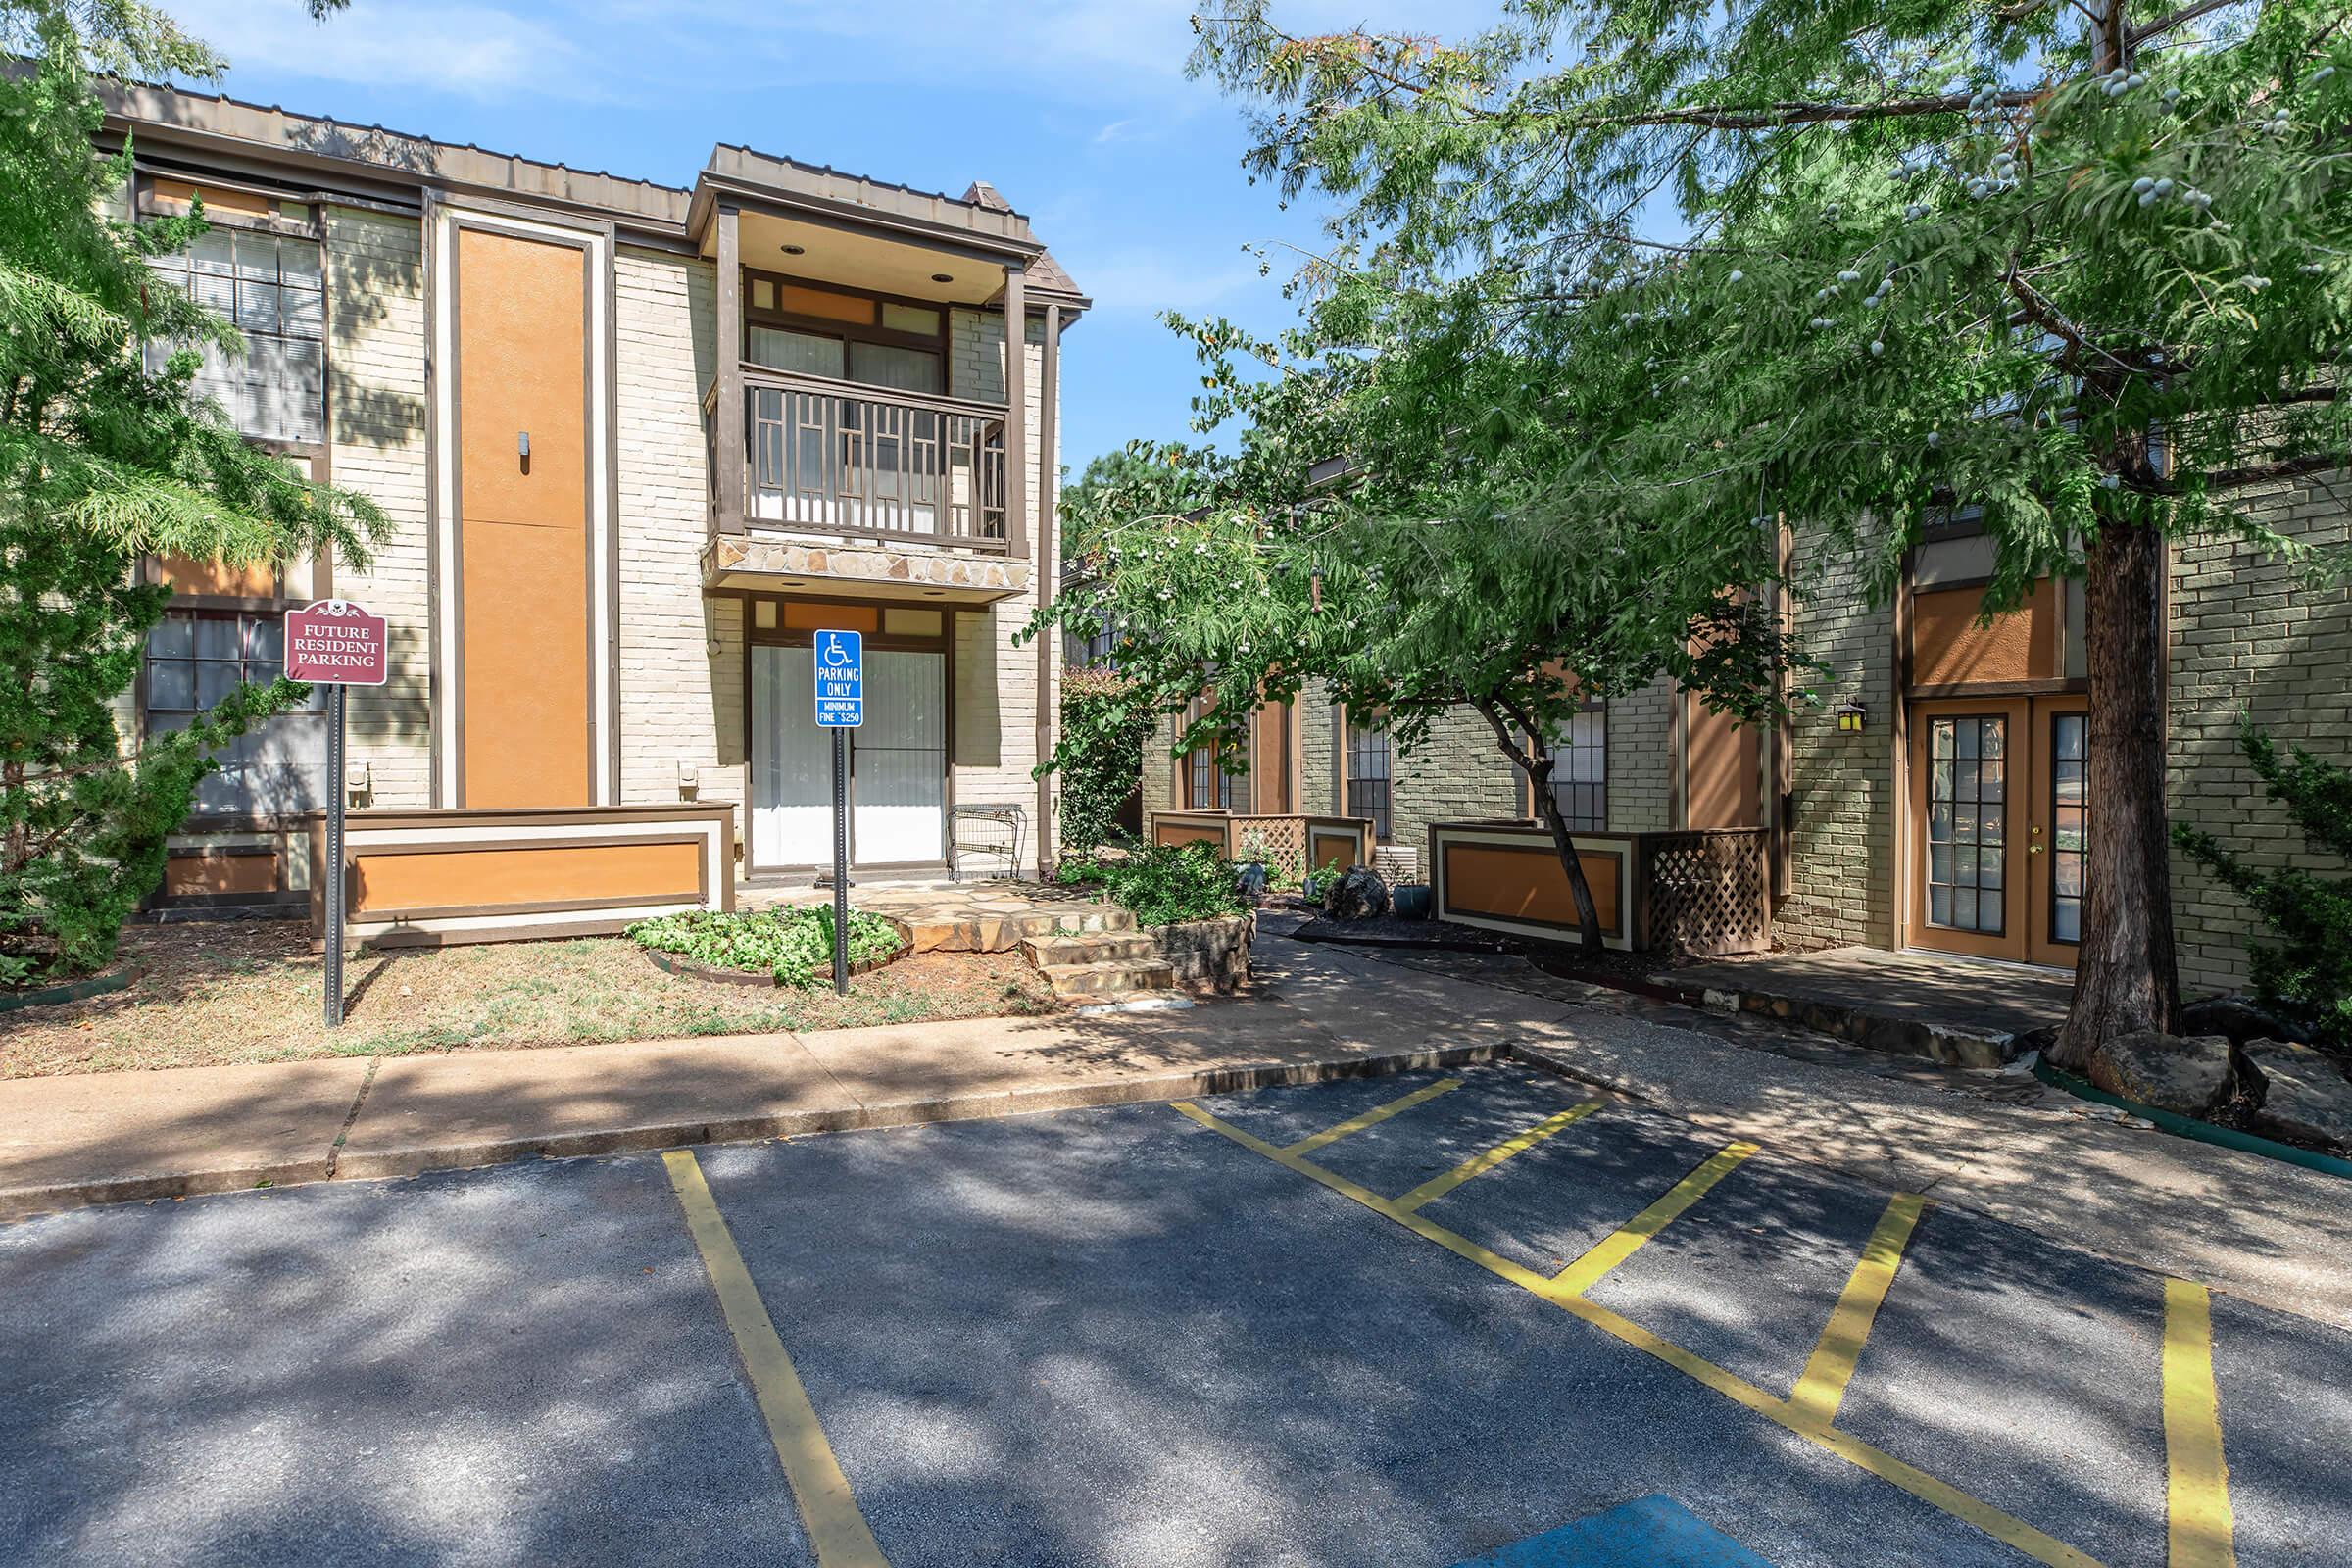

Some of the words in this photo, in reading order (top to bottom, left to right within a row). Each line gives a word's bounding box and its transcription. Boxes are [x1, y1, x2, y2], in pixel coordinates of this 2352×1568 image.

[304, 624, 369, 639] FUTURE
[294, 638, 379, 654] RESIDENT
[297, 653, 375, 667] PARKING
[818, 667, 859, 681] PARKING
[827, 682, 852, 696] ONLY
[824, 702, 855, 710] MINIMUM
[819, 712, 835, 722] FINE
[841, 713, 859, 722] $250
